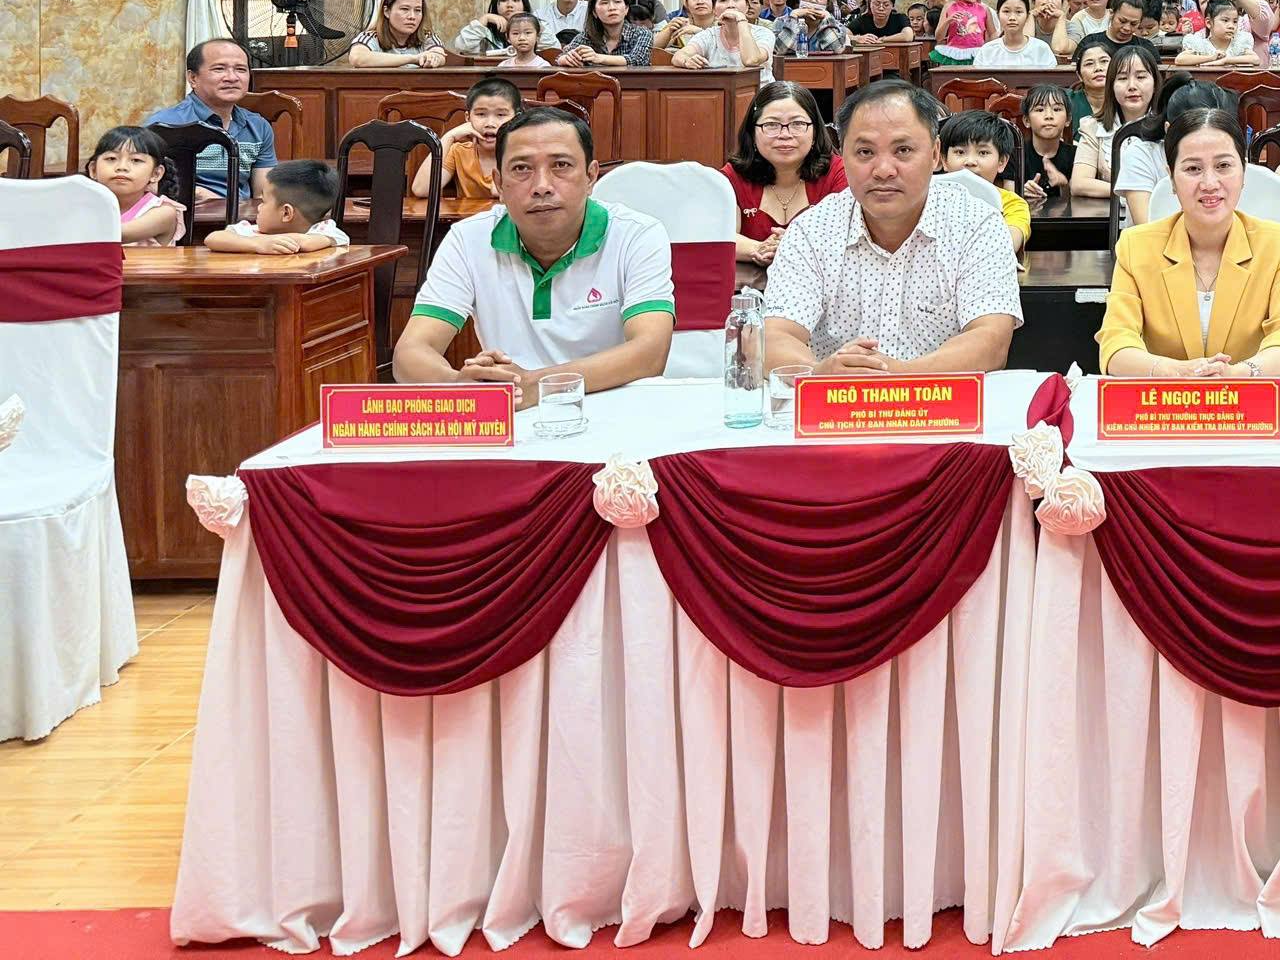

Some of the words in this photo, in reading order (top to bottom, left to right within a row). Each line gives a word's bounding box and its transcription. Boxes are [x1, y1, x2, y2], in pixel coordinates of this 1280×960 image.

[827, 386, 857, 403] NGÔ
[862, 388, 909, 402] THANH
[914, 384, 952, 401] TOÀN
[1142, 389, 1157, 405] LÊ
[1162, 391, 1200, 408] NGỌC
